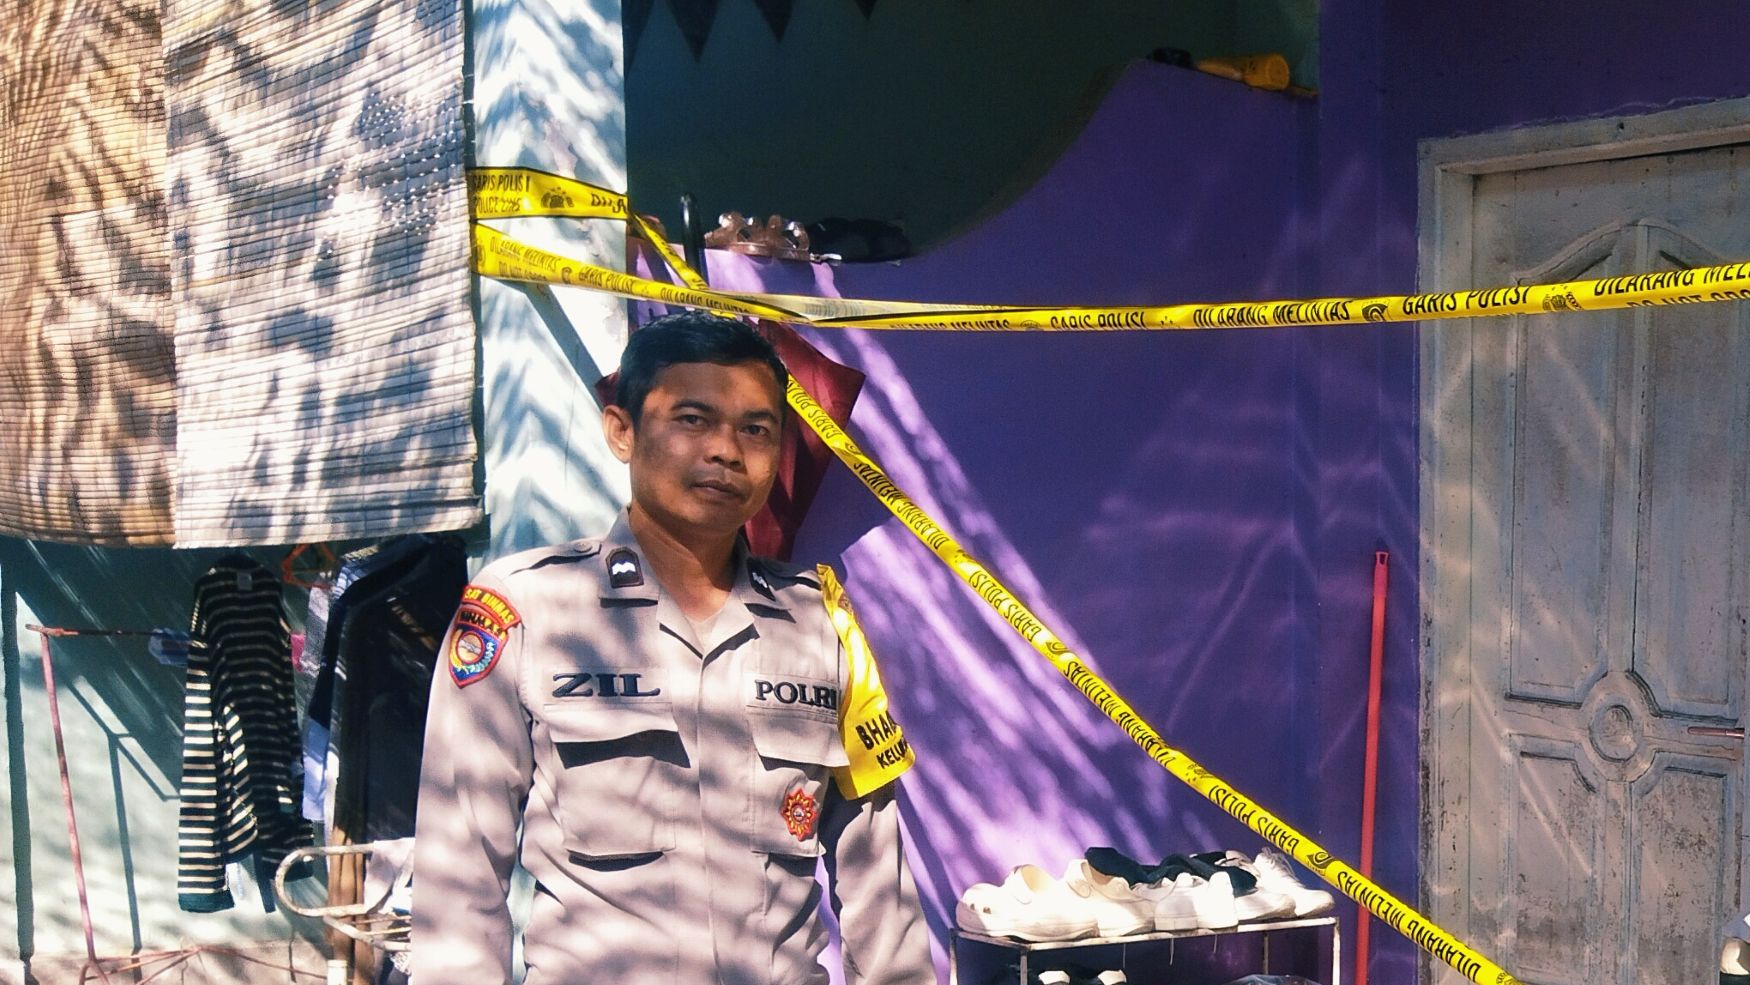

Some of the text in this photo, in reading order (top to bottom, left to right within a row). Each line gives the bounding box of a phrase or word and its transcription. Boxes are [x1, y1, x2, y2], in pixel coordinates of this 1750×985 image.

[1401, 285, 1533, 316] GARIS POLISI
[1593, 267, 1695, 297] DILARANG
[1193, 300, 1351, 328] DILARANG MELINTAS
[853, 462, 950, 550] DILARANG MELINTAS
[969, 570, 1042, 642] GARIS POLISI
[551, 672, 661, 698] ZIL
[1063, 660, 1115, 718] MELINTAS
[1208, 784, 1300, 856] GARIS POLISI
[1336, 870, 1482, 983] DILARANG MELINTAS
